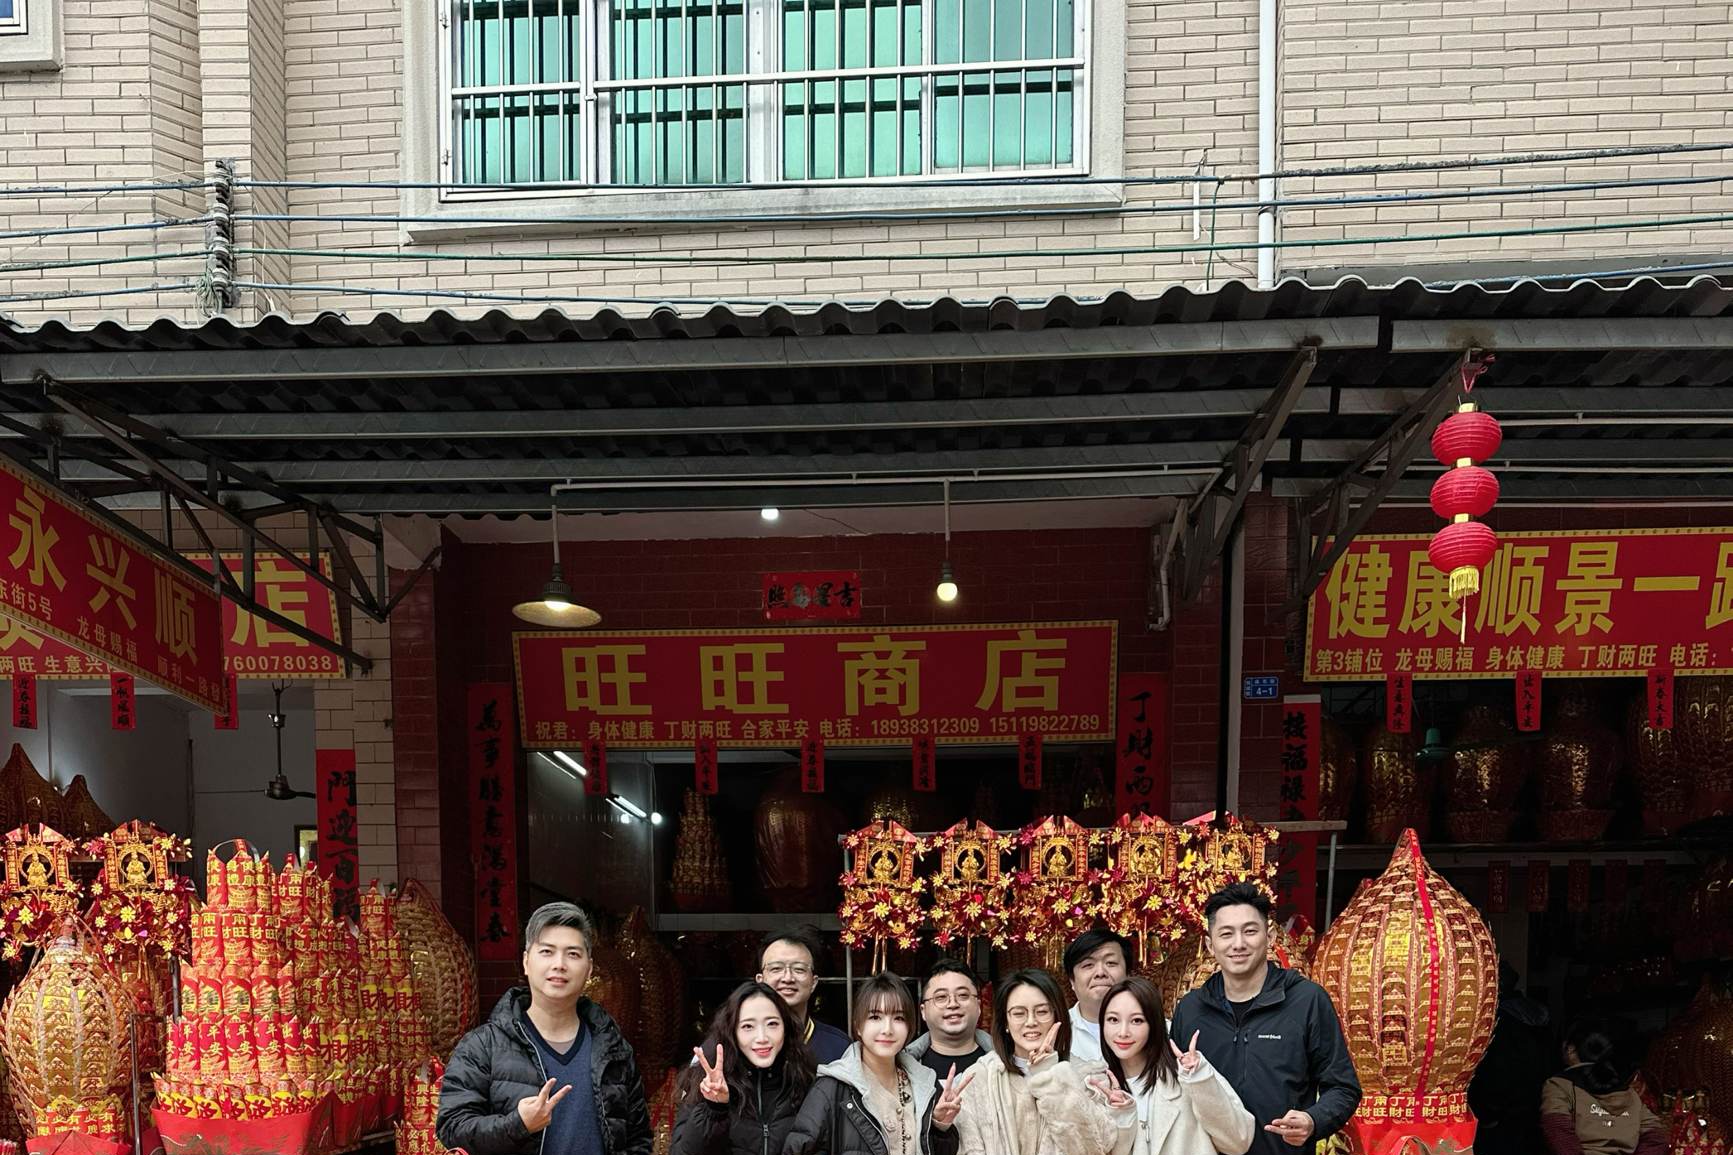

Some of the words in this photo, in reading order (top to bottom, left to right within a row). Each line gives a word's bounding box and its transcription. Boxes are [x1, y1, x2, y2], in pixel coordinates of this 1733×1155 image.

[8, 484, 199, 666] 永兴顺
[230, 560, 309, 648] 店
[77, 615, 138, 664] 龙母赐福
[1315, 649, 1384, 674] 第3铺位
[1394, 646, 1475, 672] 龙母赐福
[1485, 644, 1566, 671] 身体健康
[1578, 643, 1658, 669] 丁财两旺
[562, 629, 1067, 715] 旺旺商店
[1256, 686, 1273, 697] 4-1
[664, 719, 732, 740] 丁财两旺
[741, 717, 810, 740] 合家平安
[989, 714, 1100, 734] 15119822789
